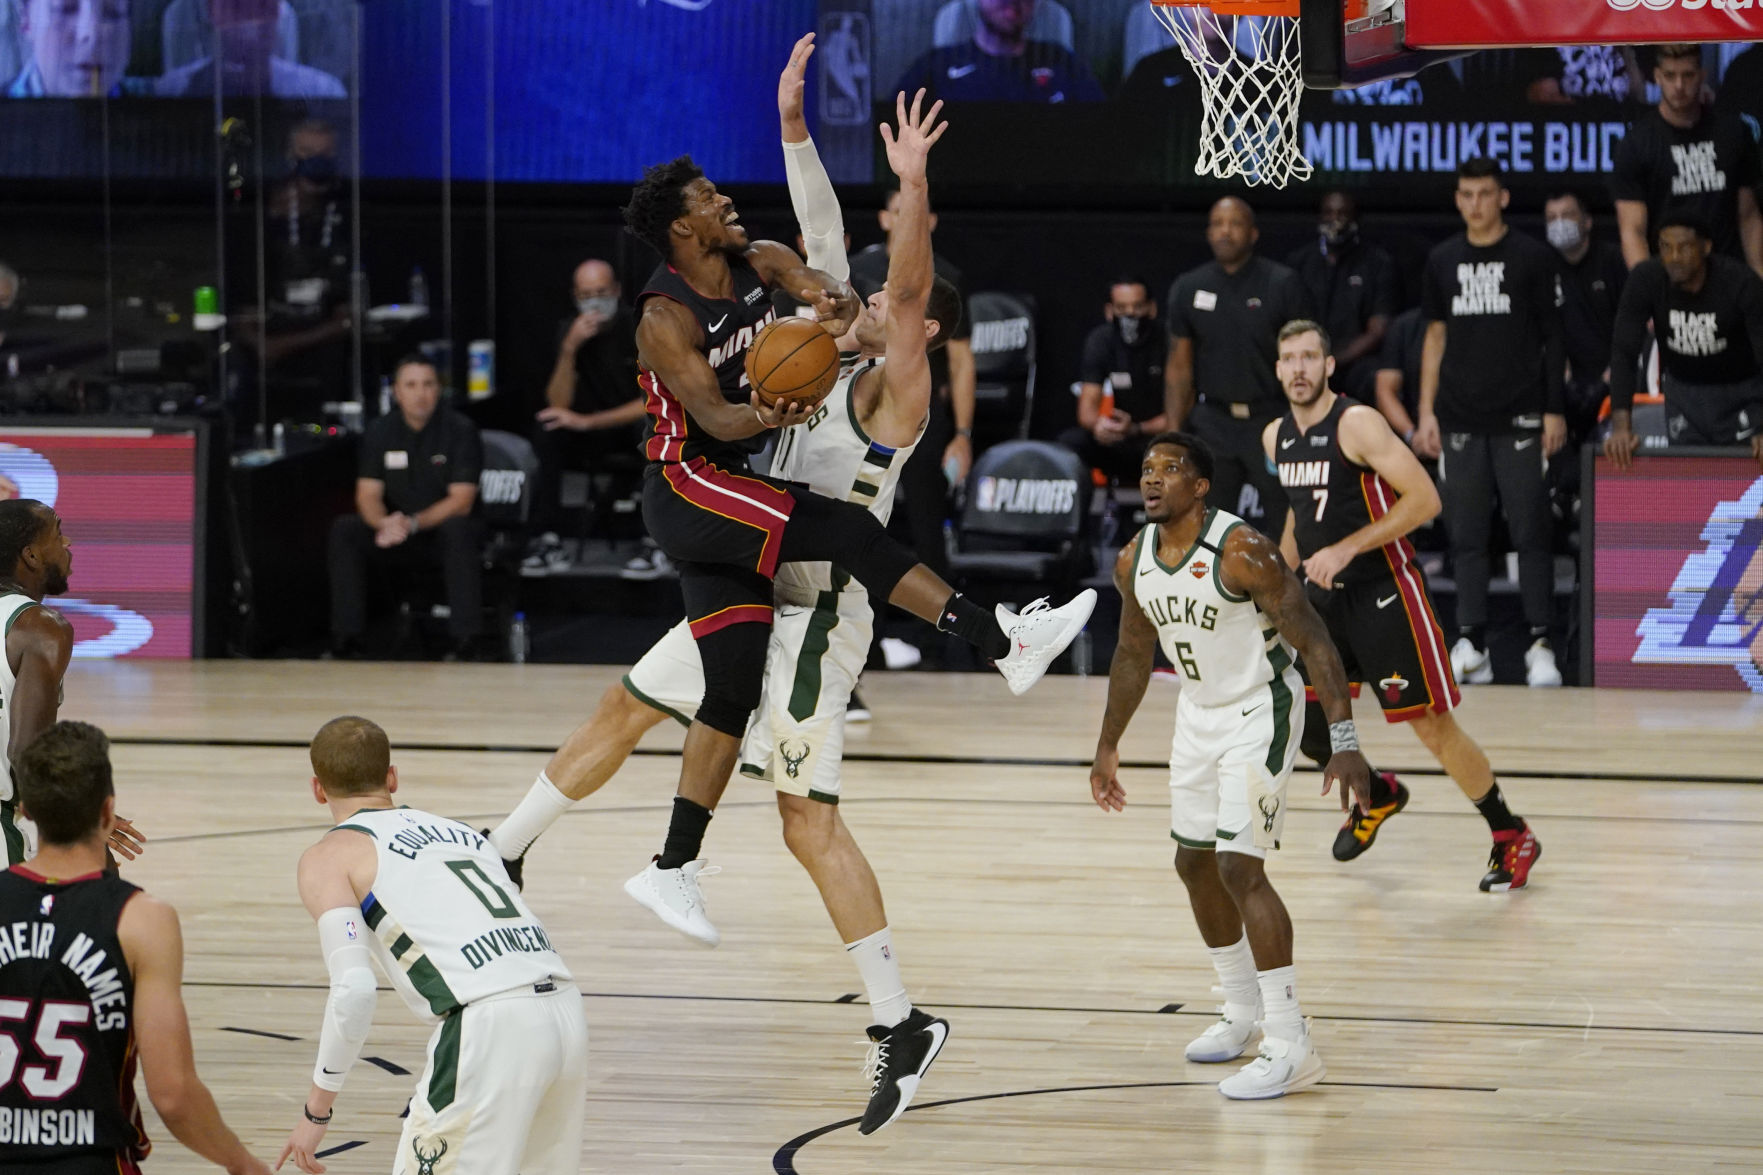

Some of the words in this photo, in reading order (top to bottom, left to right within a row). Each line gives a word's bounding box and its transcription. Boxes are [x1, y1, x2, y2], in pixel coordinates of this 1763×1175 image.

[1303, 121, 1534, 172] MILWAUKEE
[1544, 121, 1631, 172] BUC
[1670, 141, 1717, 163] BLACK
[1671, 171, 1727, 196] MATTER
[1677, 158, 1716, 178] LIVES
[1457, 262, 1505, 282] BLACK
[1461, 279, 1500, 297] LIVES
[1451, 294, 1512, 317] MATTER
[1669, 309, 1718, 331] BLACK
[1674, 326, 1716, 345] LIVES
[1278, 461, 1330, 487] MIAMI
[995, 478, 1078, 514] PLAYOFFS
[1237, 483, 1265, 518] PL
[1312, 488, 1329, 522] 7
[1144, 595, 1219, 631] UCKS
[1174, 641, 1202, 682] 6
[388, 825, 484, 861] EQUALITY
[444, 859, 521, 919] 0
[460, 925, 557, 970] DIVINCEN
[0, 921, 56, 968] HEIR
[60, 931, 127, 1032] NAMES
